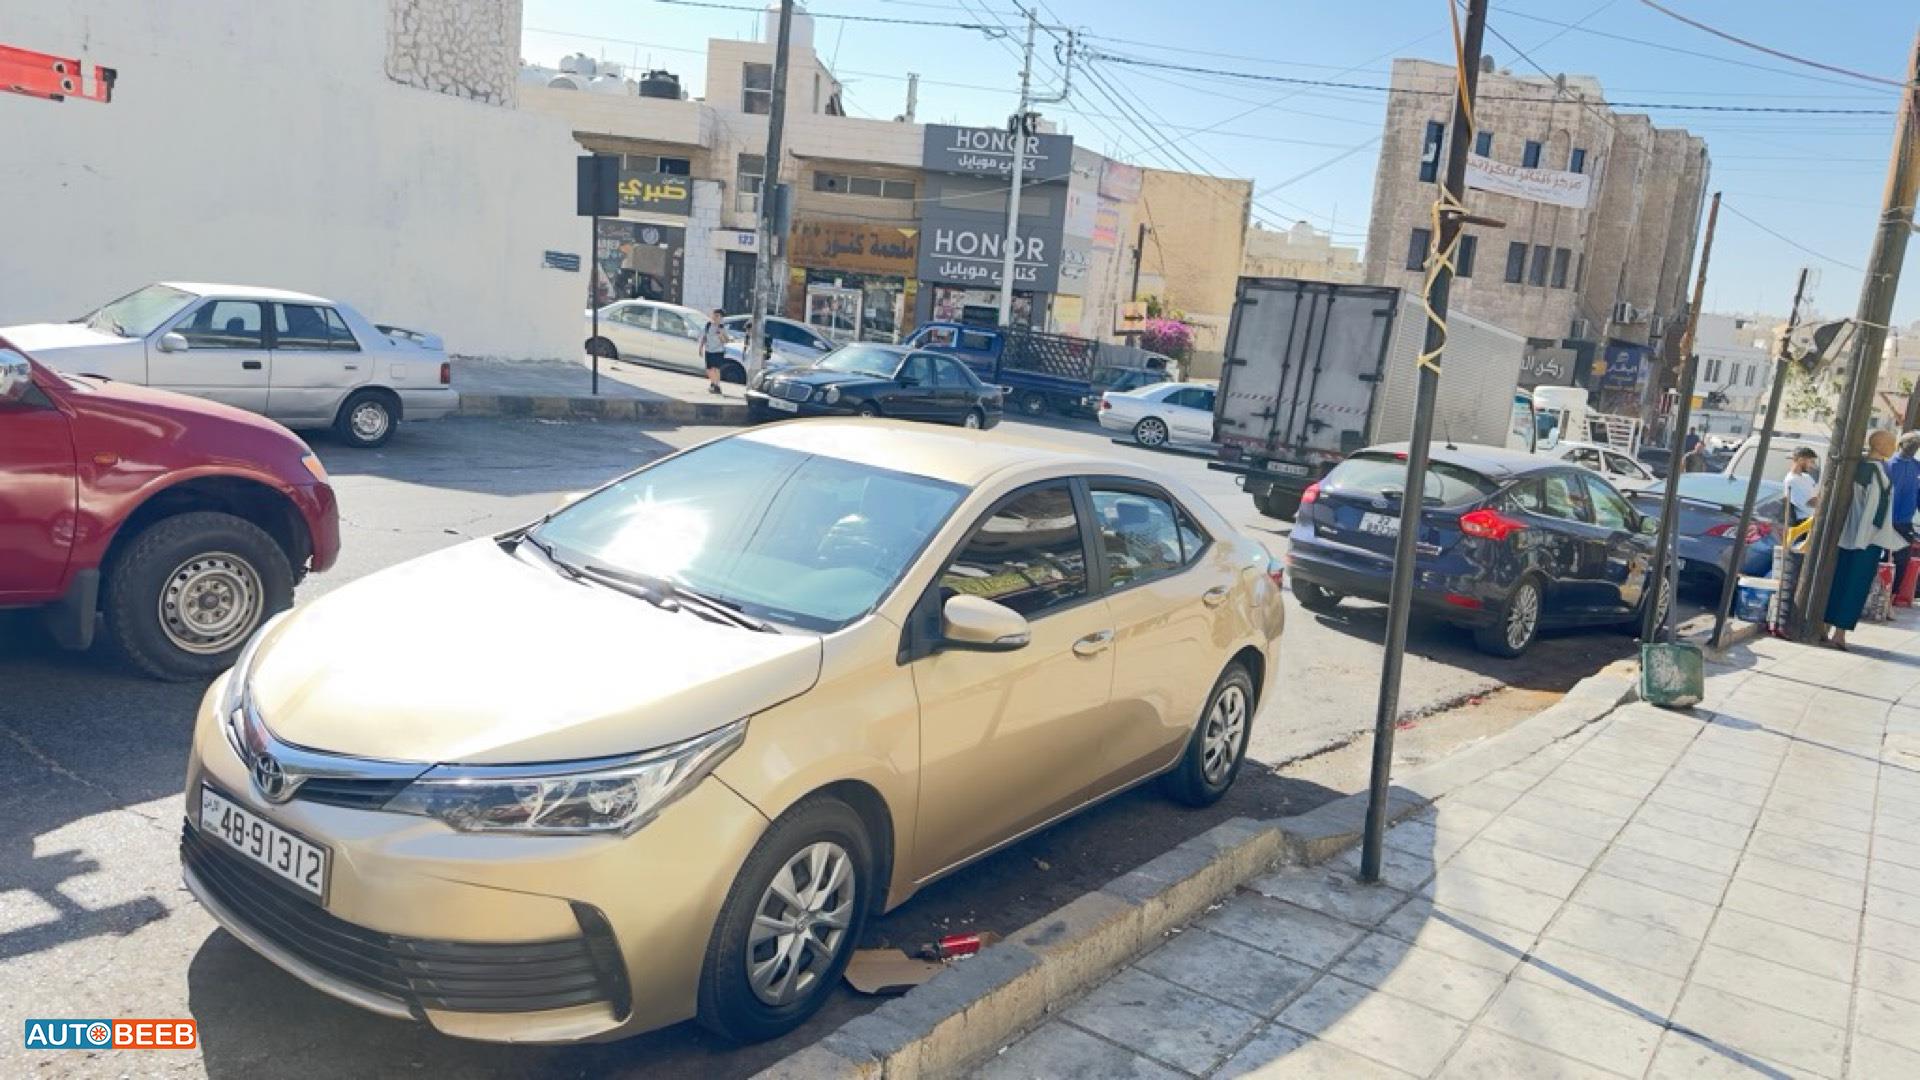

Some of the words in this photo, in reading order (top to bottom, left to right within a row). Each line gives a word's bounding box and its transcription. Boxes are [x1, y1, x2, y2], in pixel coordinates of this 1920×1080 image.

[956, 129, 1040, 154] HONOR
[935, 229, 1044, 261] HONOR
[940, 261, 988, 279] موبايل
[1534, 357, 1565, 379] ركن
